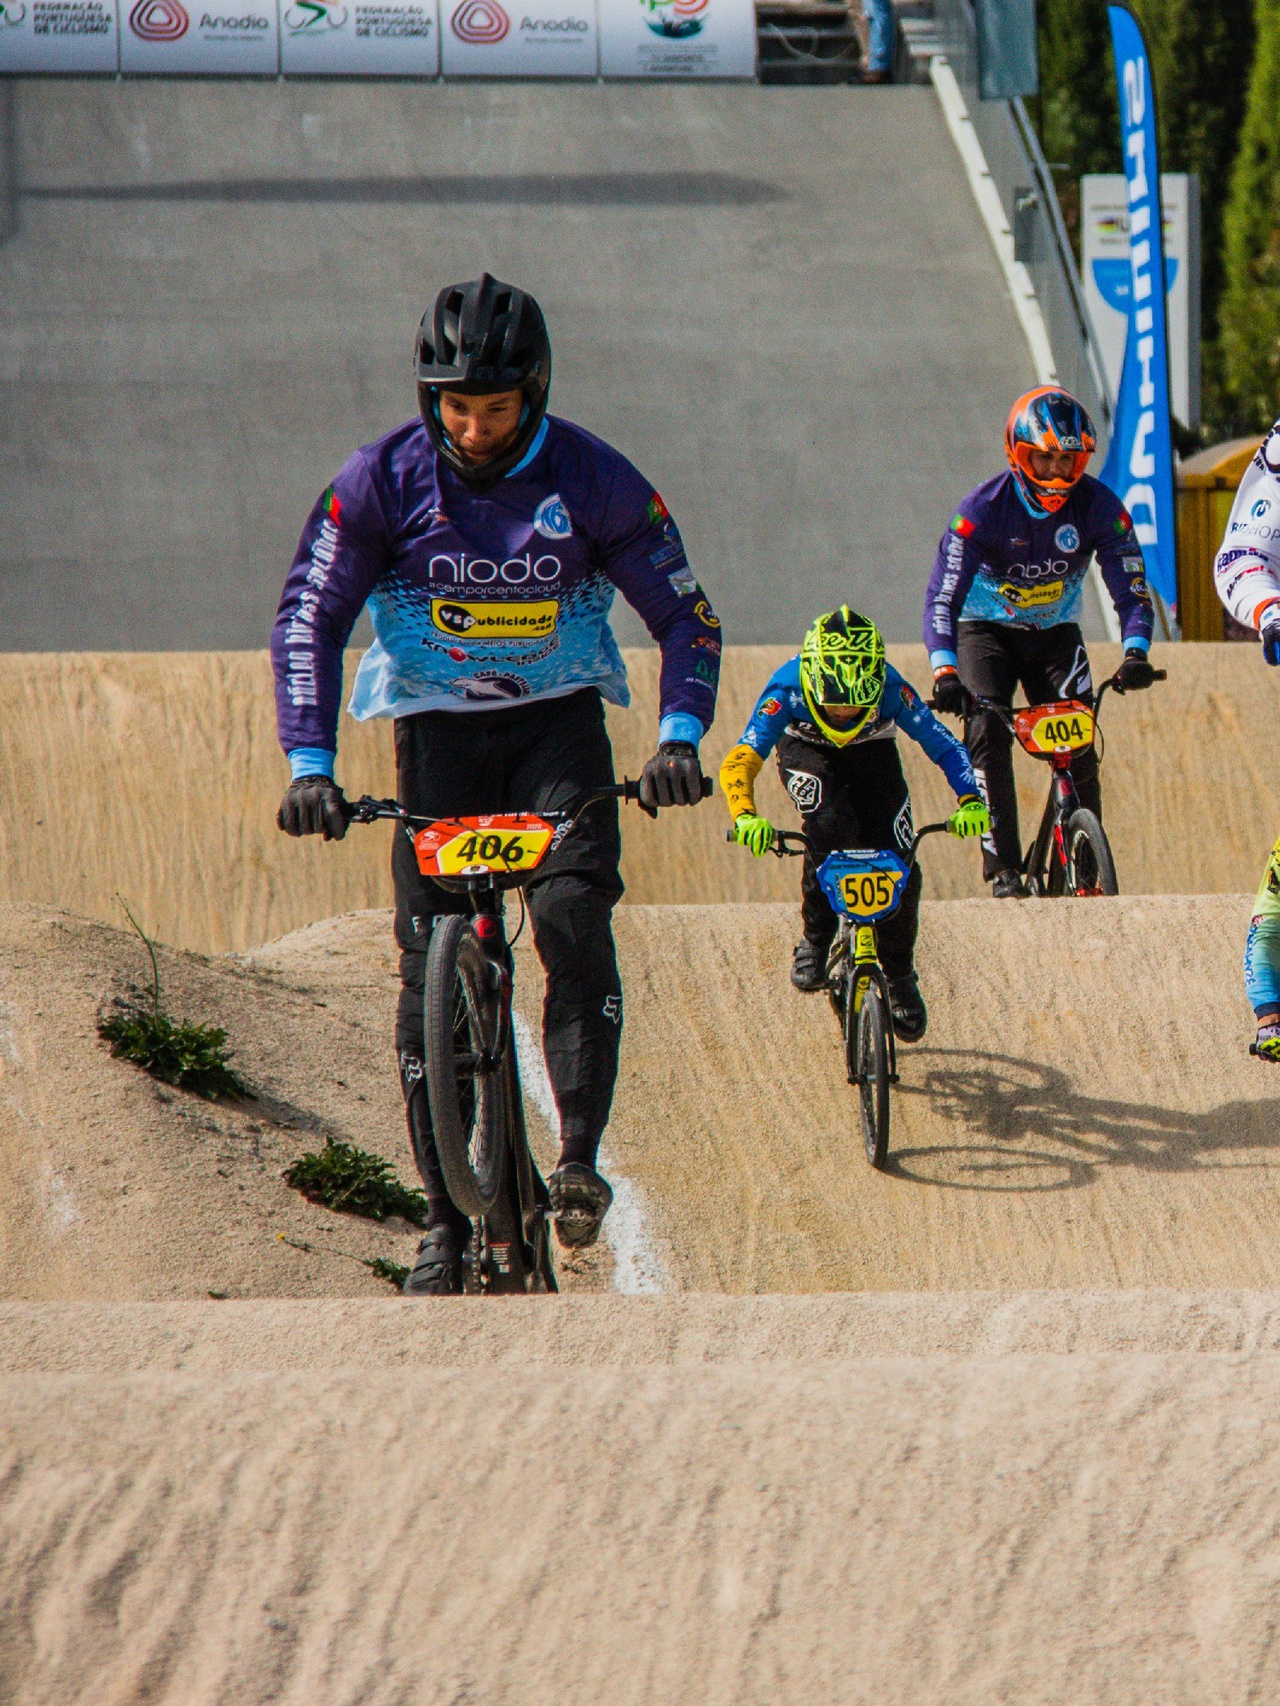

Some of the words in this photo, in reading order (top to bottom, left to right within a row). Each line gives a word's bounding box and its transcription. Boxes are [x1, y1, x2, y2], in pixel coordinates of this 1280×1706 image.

[428, 552, 562, 584] niodo
[1045, 718, 1084, 744] 404
[456, 835, 525, 863] 406
[845, 876, 891, 908] 505
